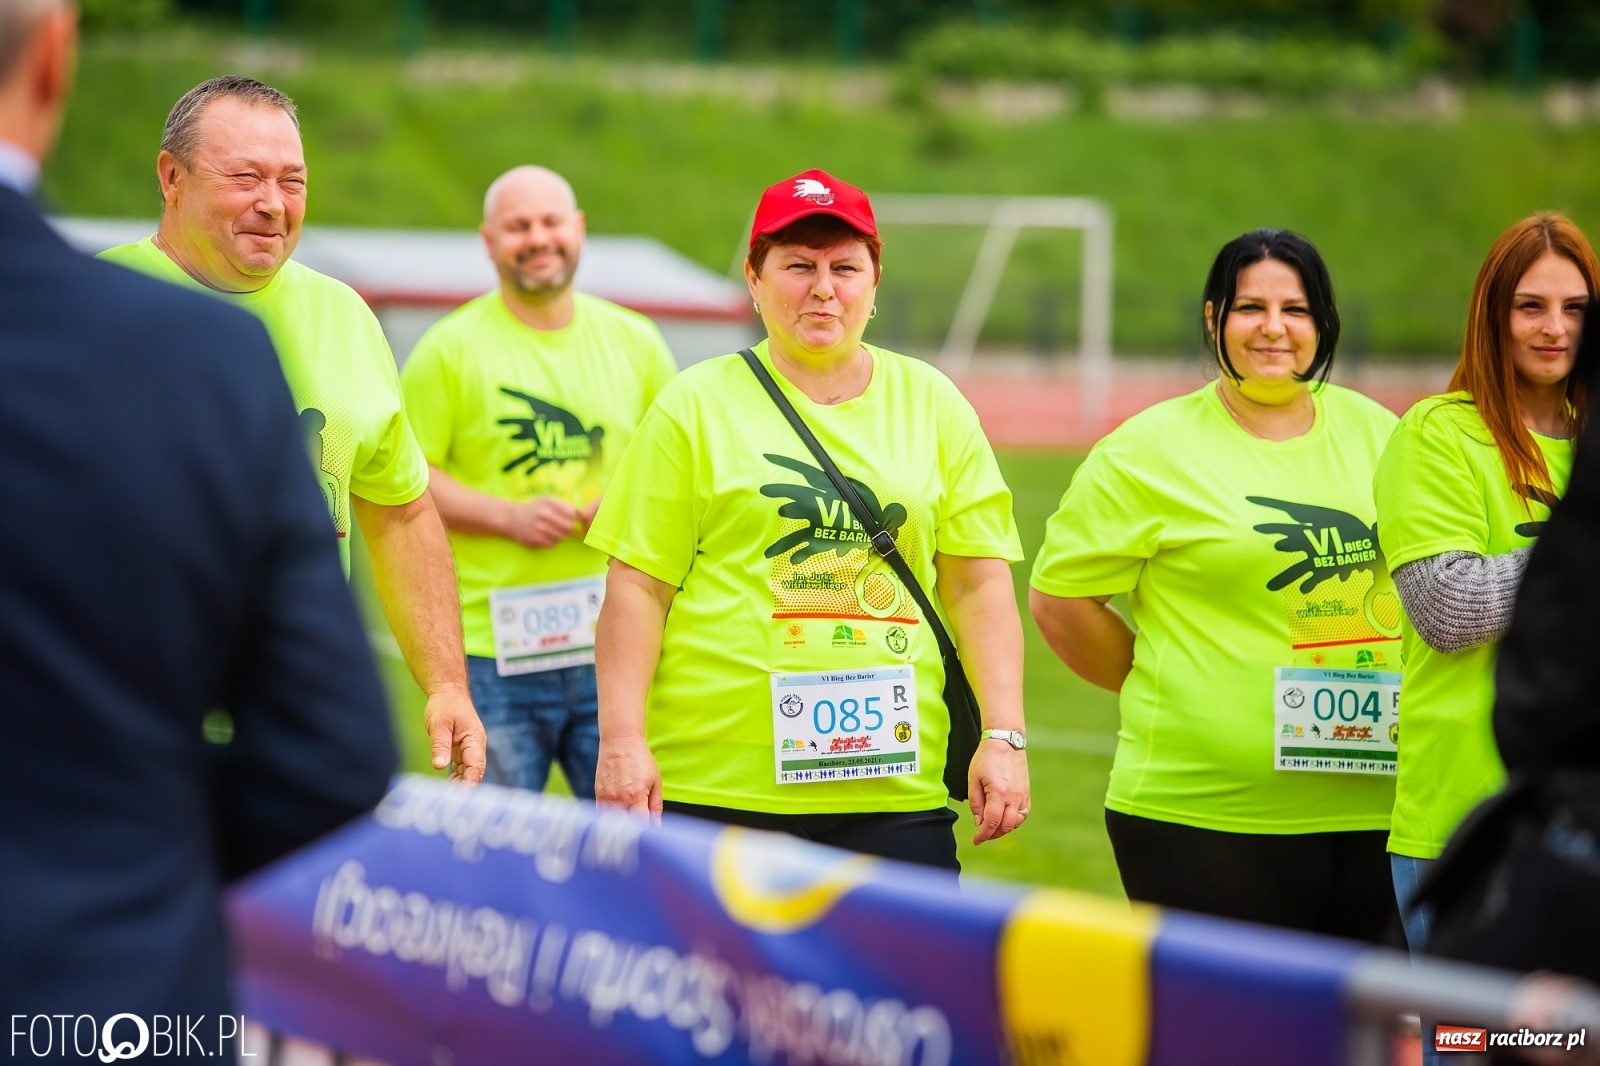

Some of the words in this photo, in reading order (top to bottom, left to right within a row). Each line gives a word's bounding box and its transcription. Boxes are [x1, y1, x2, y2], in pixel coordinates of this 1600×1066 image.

[815, 496, 851, 530] VI
[814, 527, 836, 540] BEZ
[838, 530, 871, 543] BARIE
[1303, 526, 1344, 556] VI
[1344, 538, 1372, 553] BIEG
[1313, 556, 1335, 568] BEZ
[1336, 550, 1377, 566] BARIER
[781, 580, 847, 591] Wiśniewskiego
[523, 601, 582, 636] 089
[893, 685, 908, 703] R
[1313, 688, 1382, 723] 004
[813, 696, 884, 735] 085
